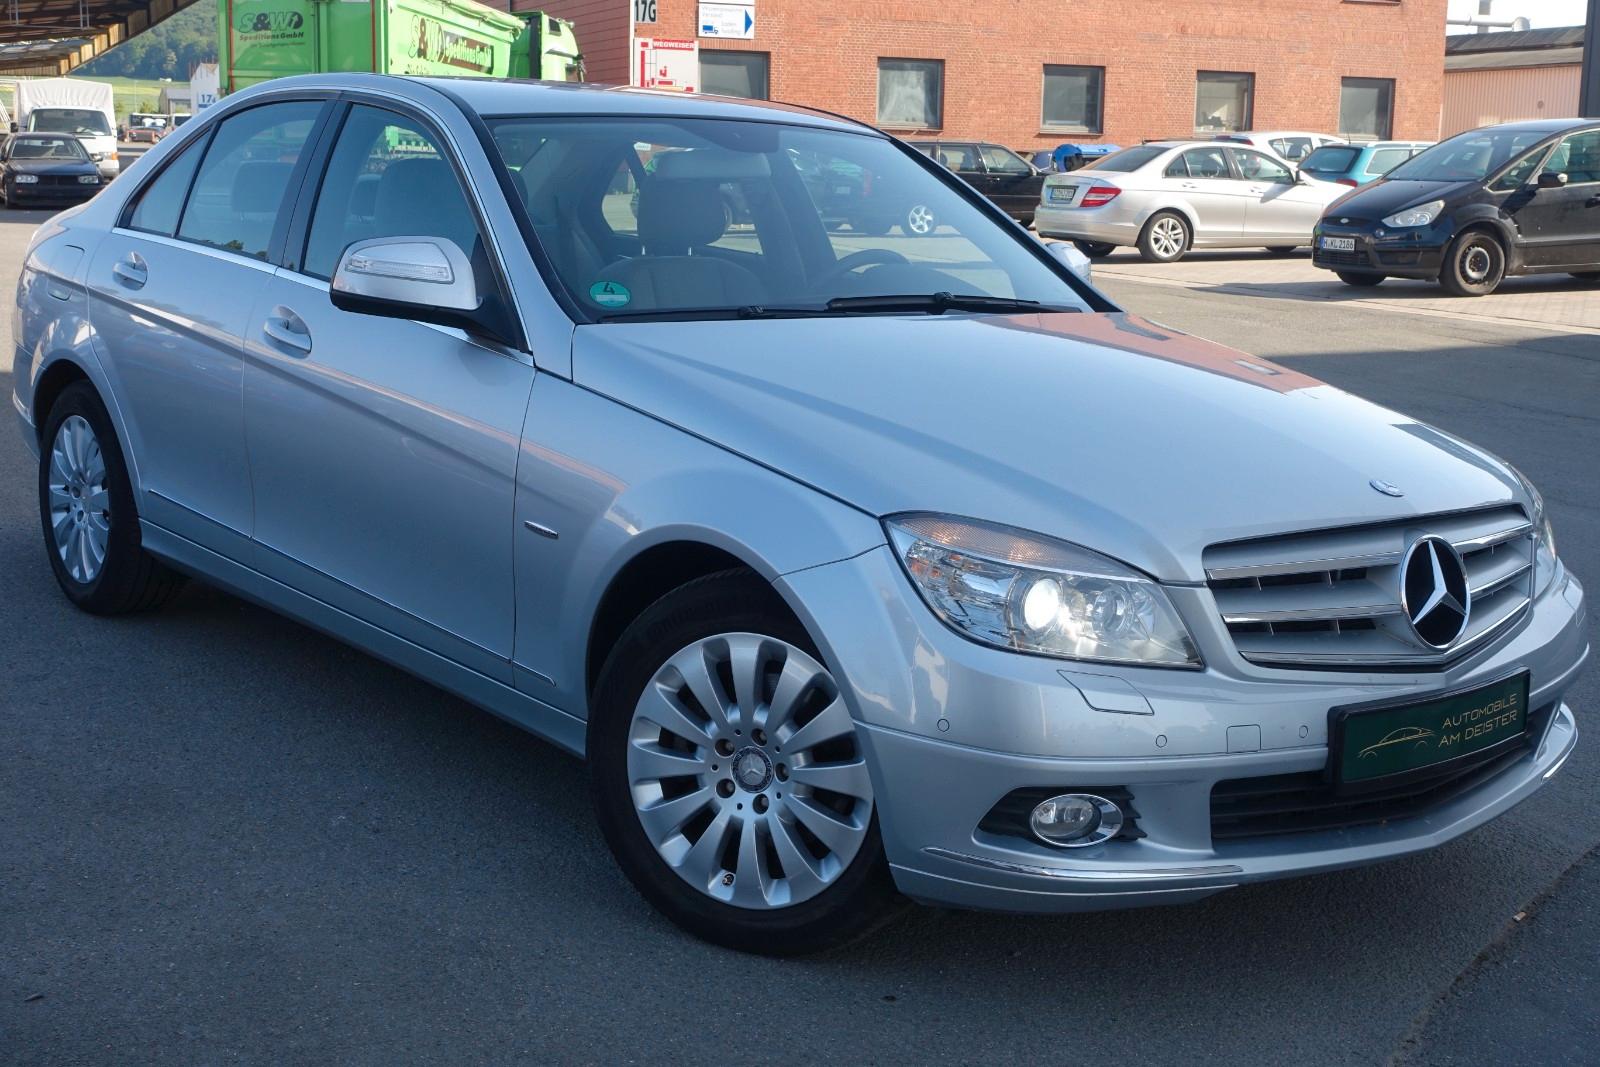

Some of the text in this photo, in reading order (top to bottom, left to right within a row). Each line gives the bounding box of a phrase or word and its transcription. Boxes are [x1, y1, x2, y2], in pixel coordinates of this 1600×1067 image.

[635, 0, 656, 22] 17G
[653, 41, 695, 49] WEGWEISER
[1339, 239, 1353, 249] 2186
[603, 282, 615, 295] 4
[1442, 693, 1518, 729] AUTOMOBILE
[1438, 709, 1518, 748] AM DEISTER
